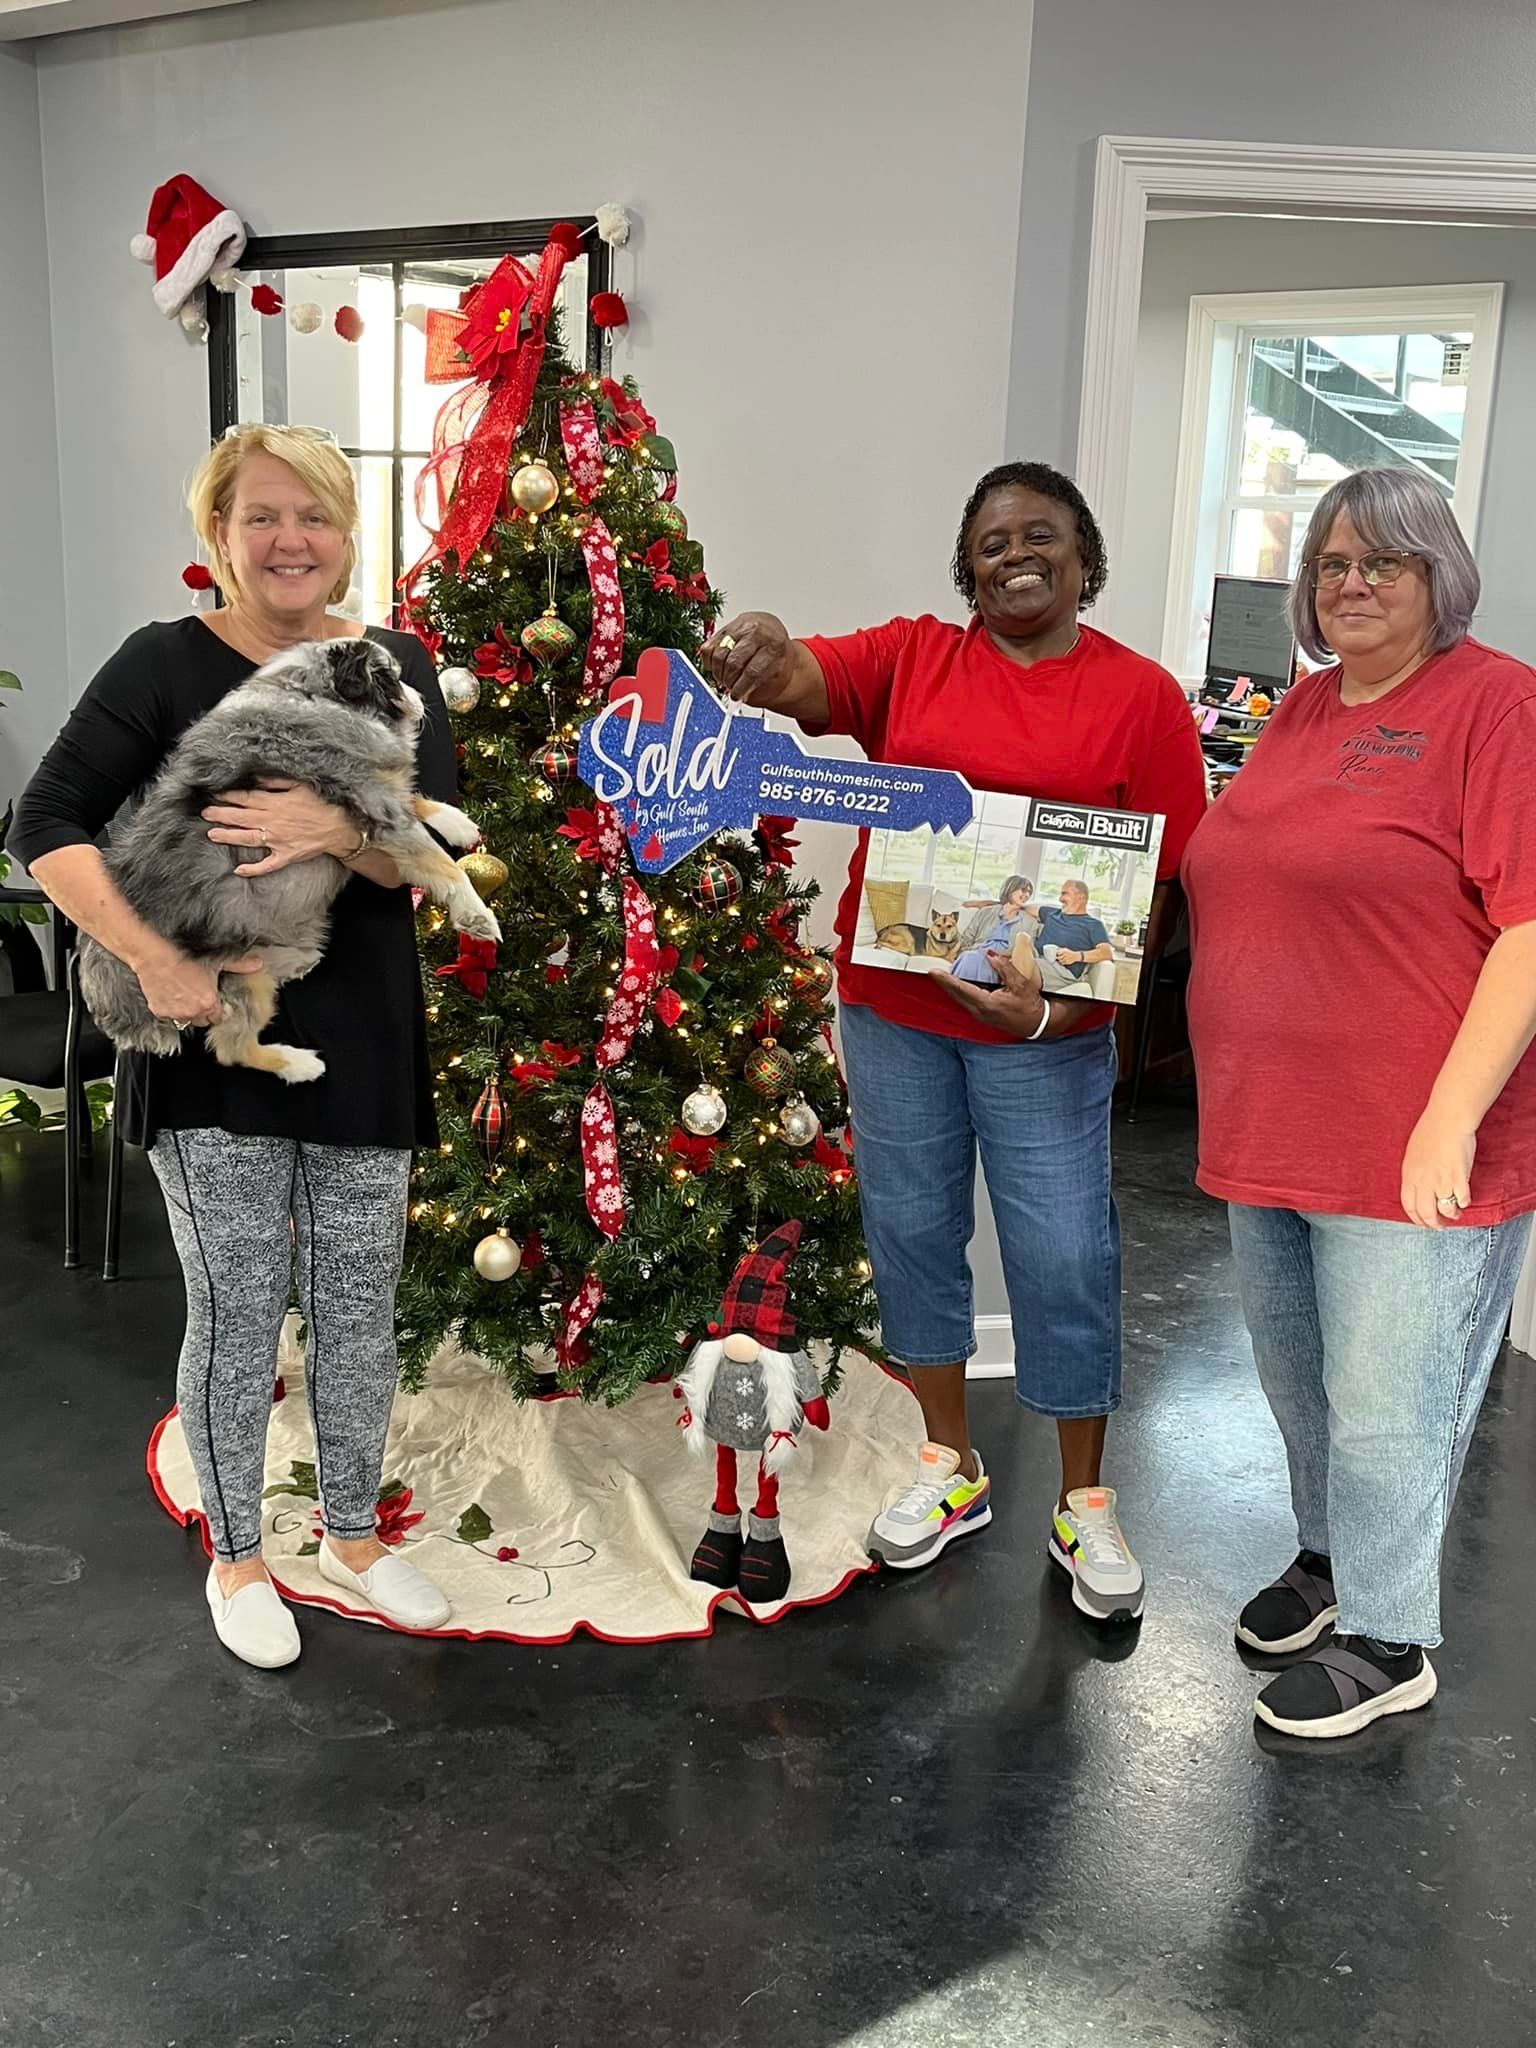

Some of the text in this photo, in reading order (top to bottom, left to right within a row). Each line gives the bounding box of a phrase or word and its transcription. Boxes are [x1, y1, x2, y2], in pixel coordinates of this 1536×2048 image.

[590, 691, 739, 803] Sold
[760, 763, 924, 793] Gulfsouthhomesinc.com
[635, 798, 709, 826] by Gulf South
[758, 780, 890, 814] 985-876-0222
[1039, 812, 1142, 840] Clayton Built
